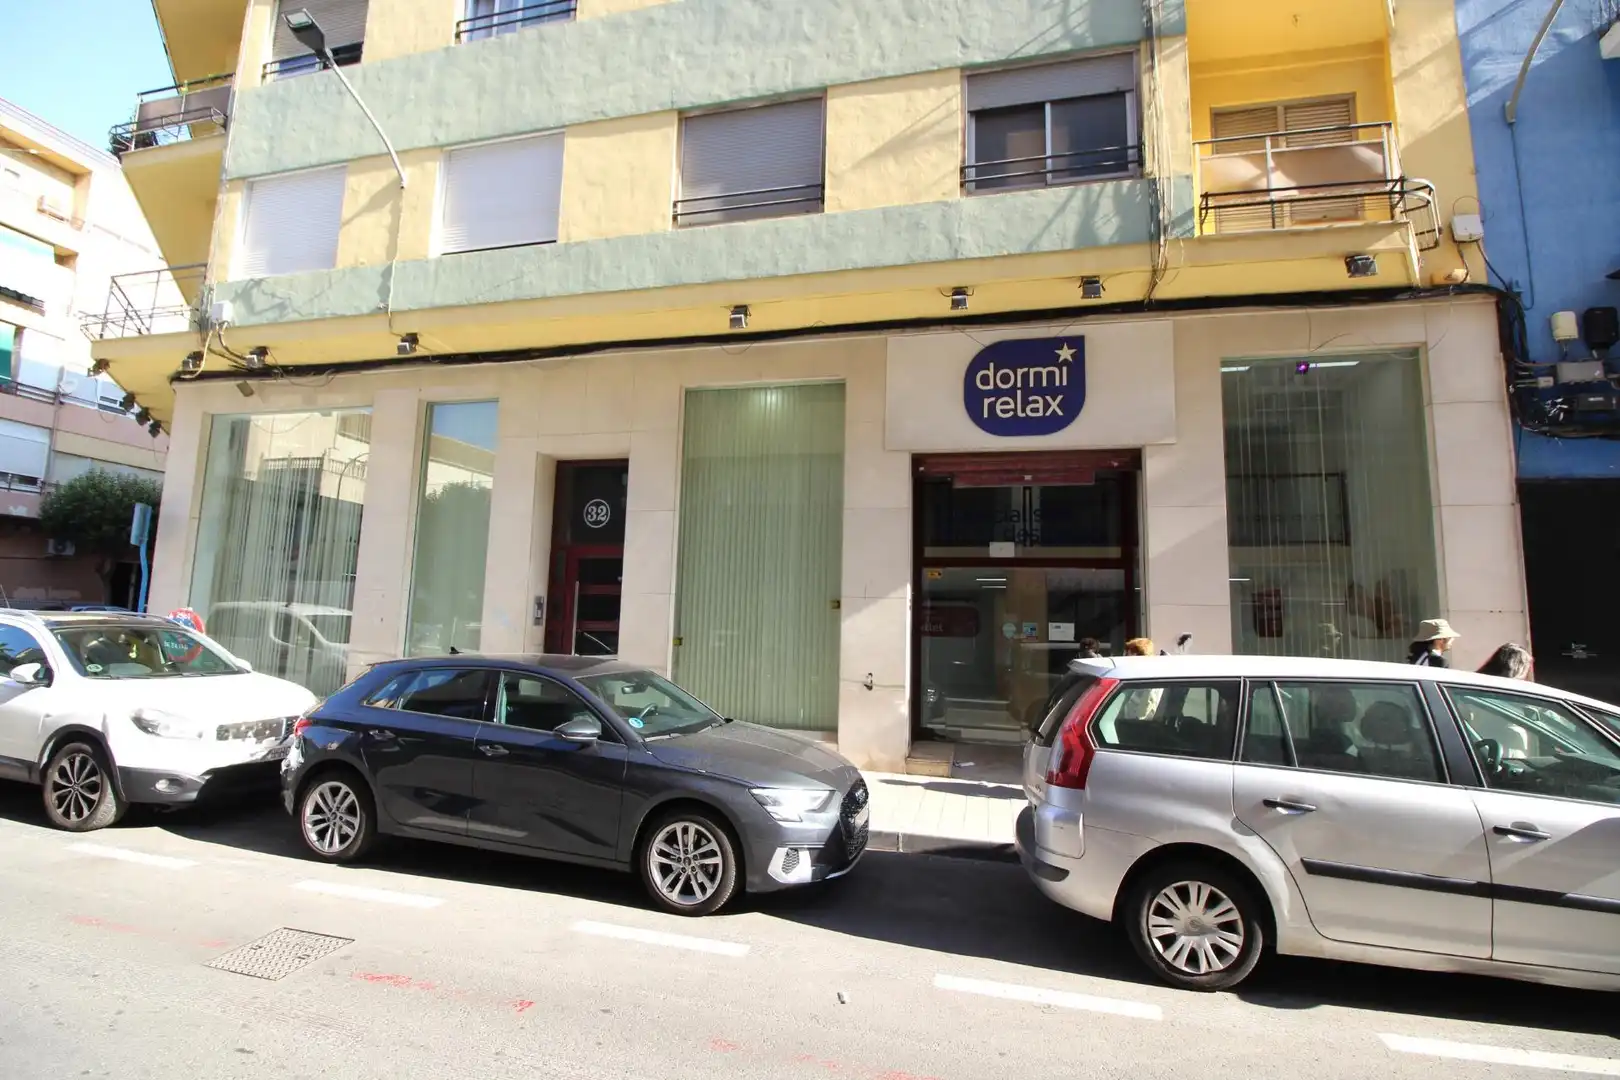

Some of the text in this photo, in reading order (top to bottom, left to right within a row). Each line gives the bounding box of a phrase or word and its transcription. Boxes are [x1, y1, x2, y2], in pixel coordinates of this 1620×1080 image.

[975, 361, 1068, 391] dormi
[983, 390, 1064, 418] relax
[587, 505, 607, 522] 32
